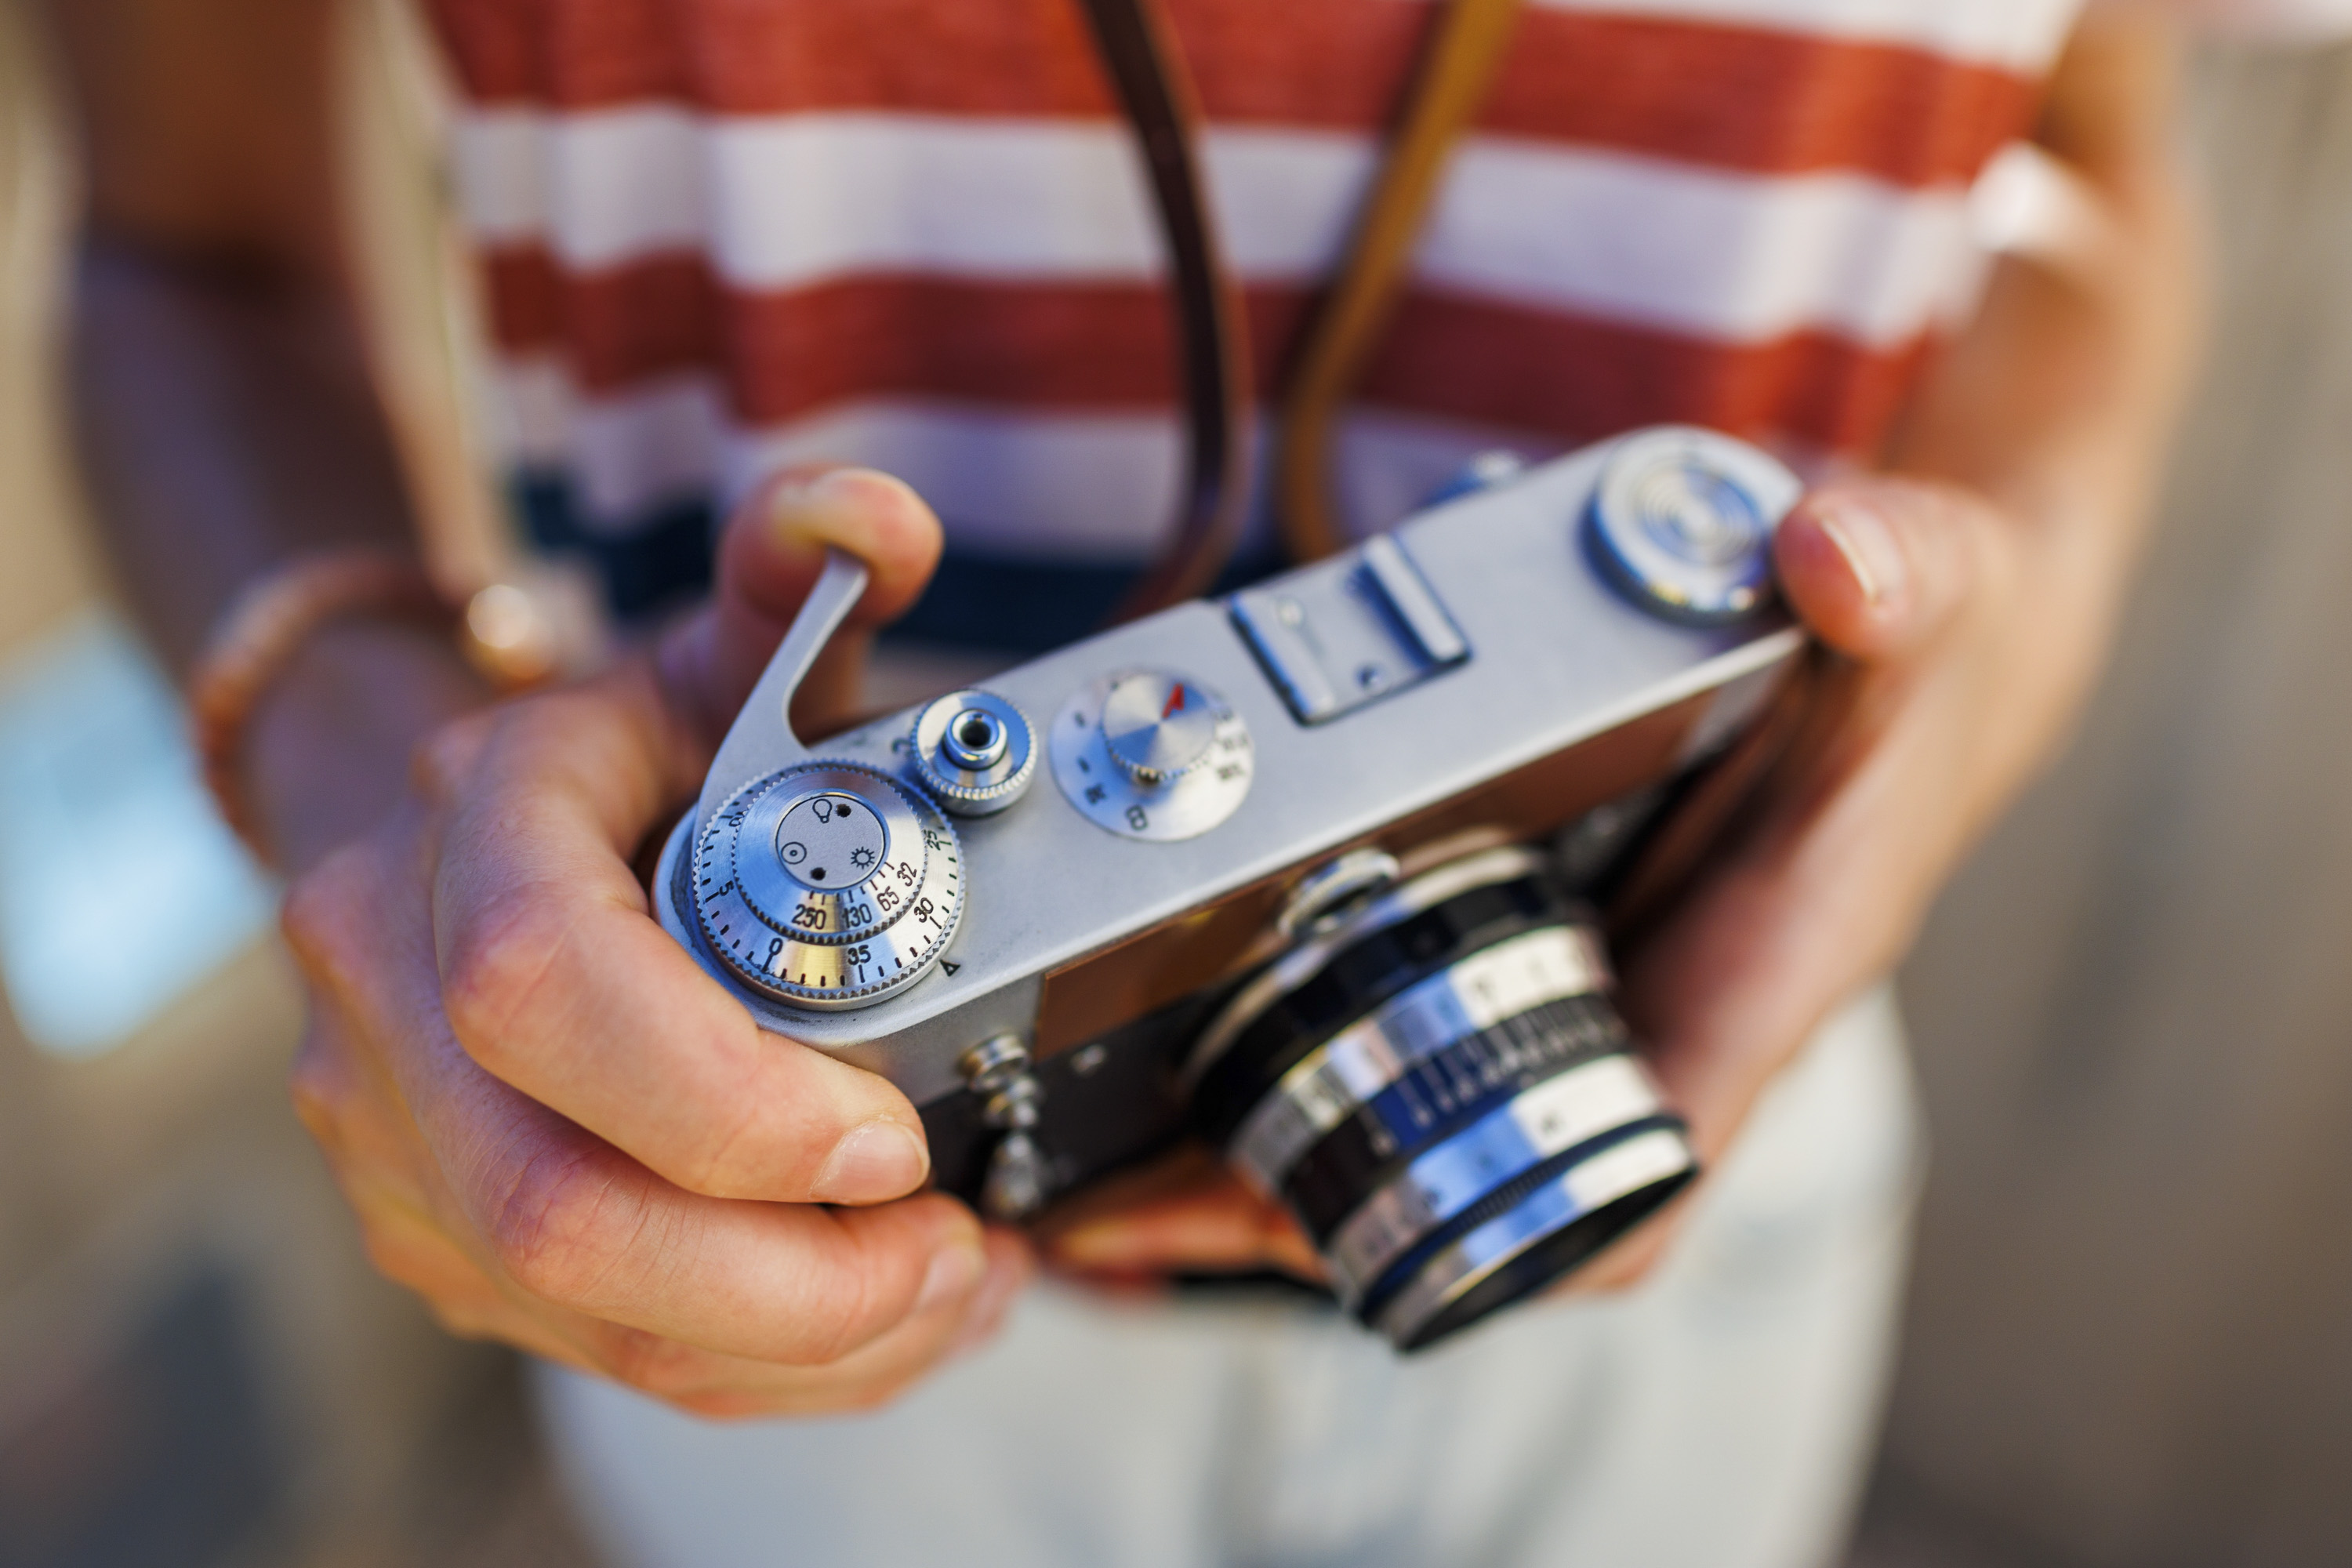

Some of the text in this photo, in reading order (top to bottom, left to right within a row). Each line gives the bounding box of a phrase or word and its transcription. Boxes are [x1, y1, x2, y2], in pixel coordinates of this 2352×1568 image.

[719, 880, 735, 896] 5
[769, 938, 783, 956] 0
[848, 944, 872, 965] 35
[914, 898, 934, 923] 30
[926, 829, 941, 851] 25
[791, 862, 916, 930] 250 130 65 32
